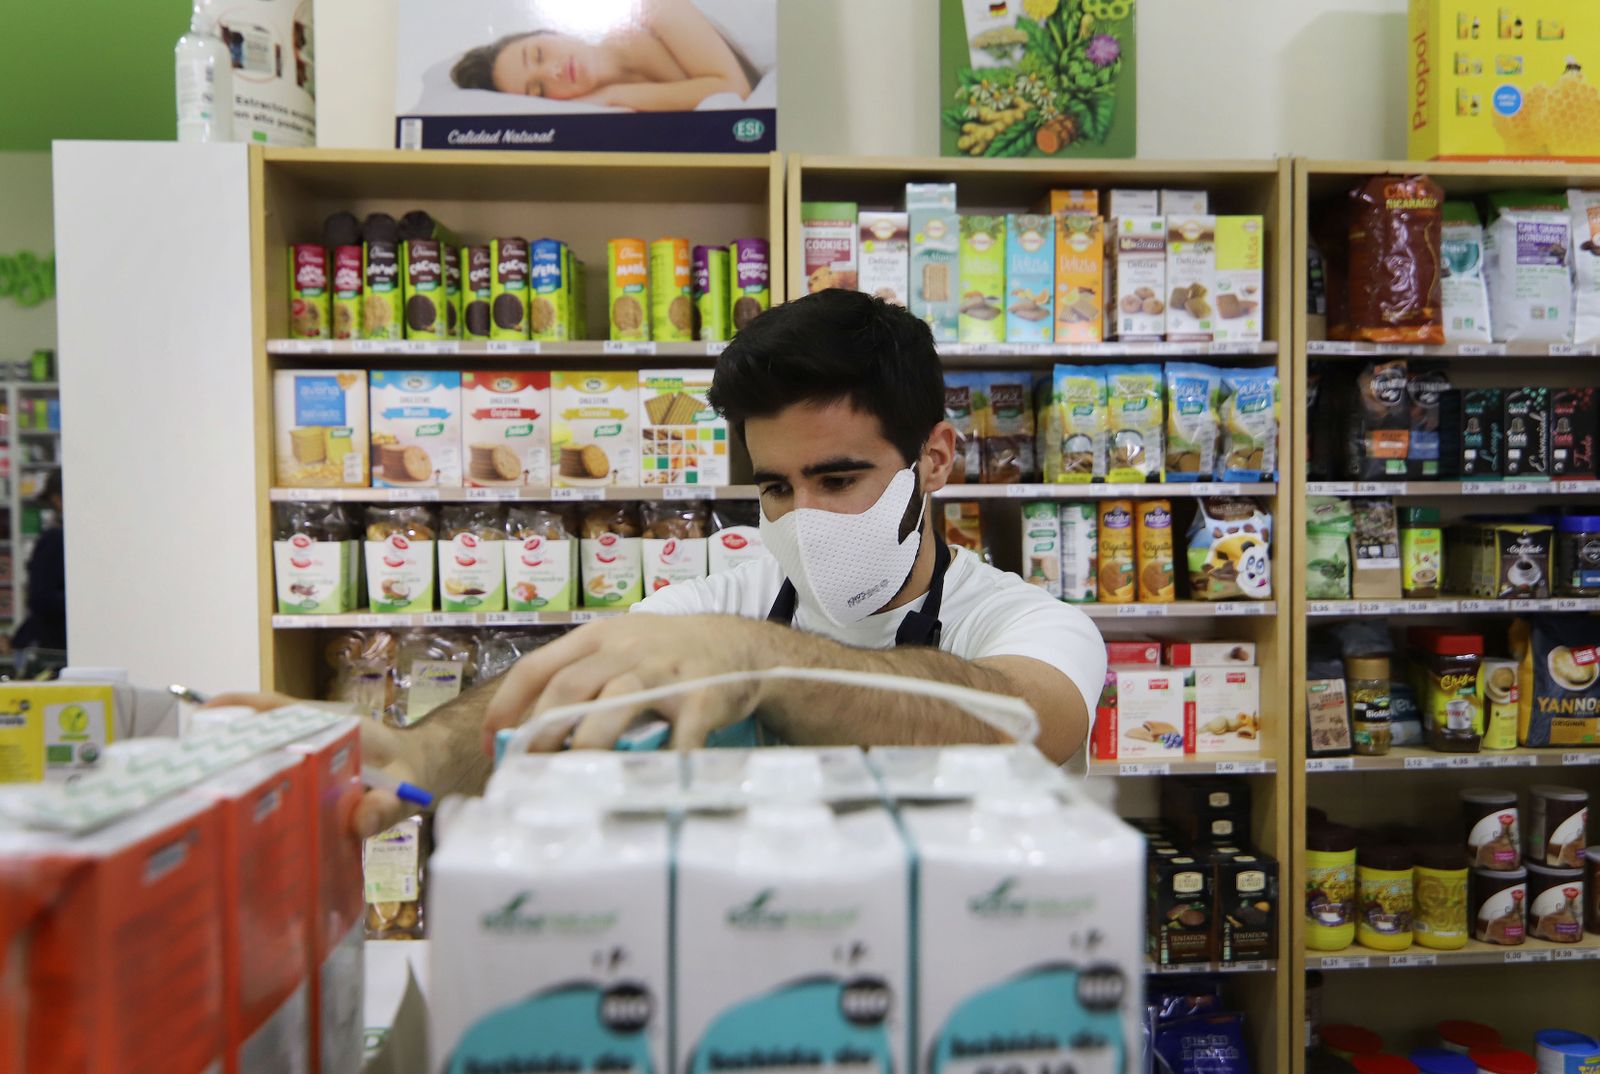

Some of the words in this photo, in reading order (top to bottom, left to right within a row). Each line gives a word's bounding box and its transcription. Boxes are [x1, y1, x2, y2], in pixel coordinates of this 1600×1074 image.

[1412, 31, 1430, 131] Propol
[447, 129, 501, 145] Calidad
[502, 128, 555, 144] Natural
[735, 121, 759, 136] ESI
[806, 239, 850, 250] COOKIES
